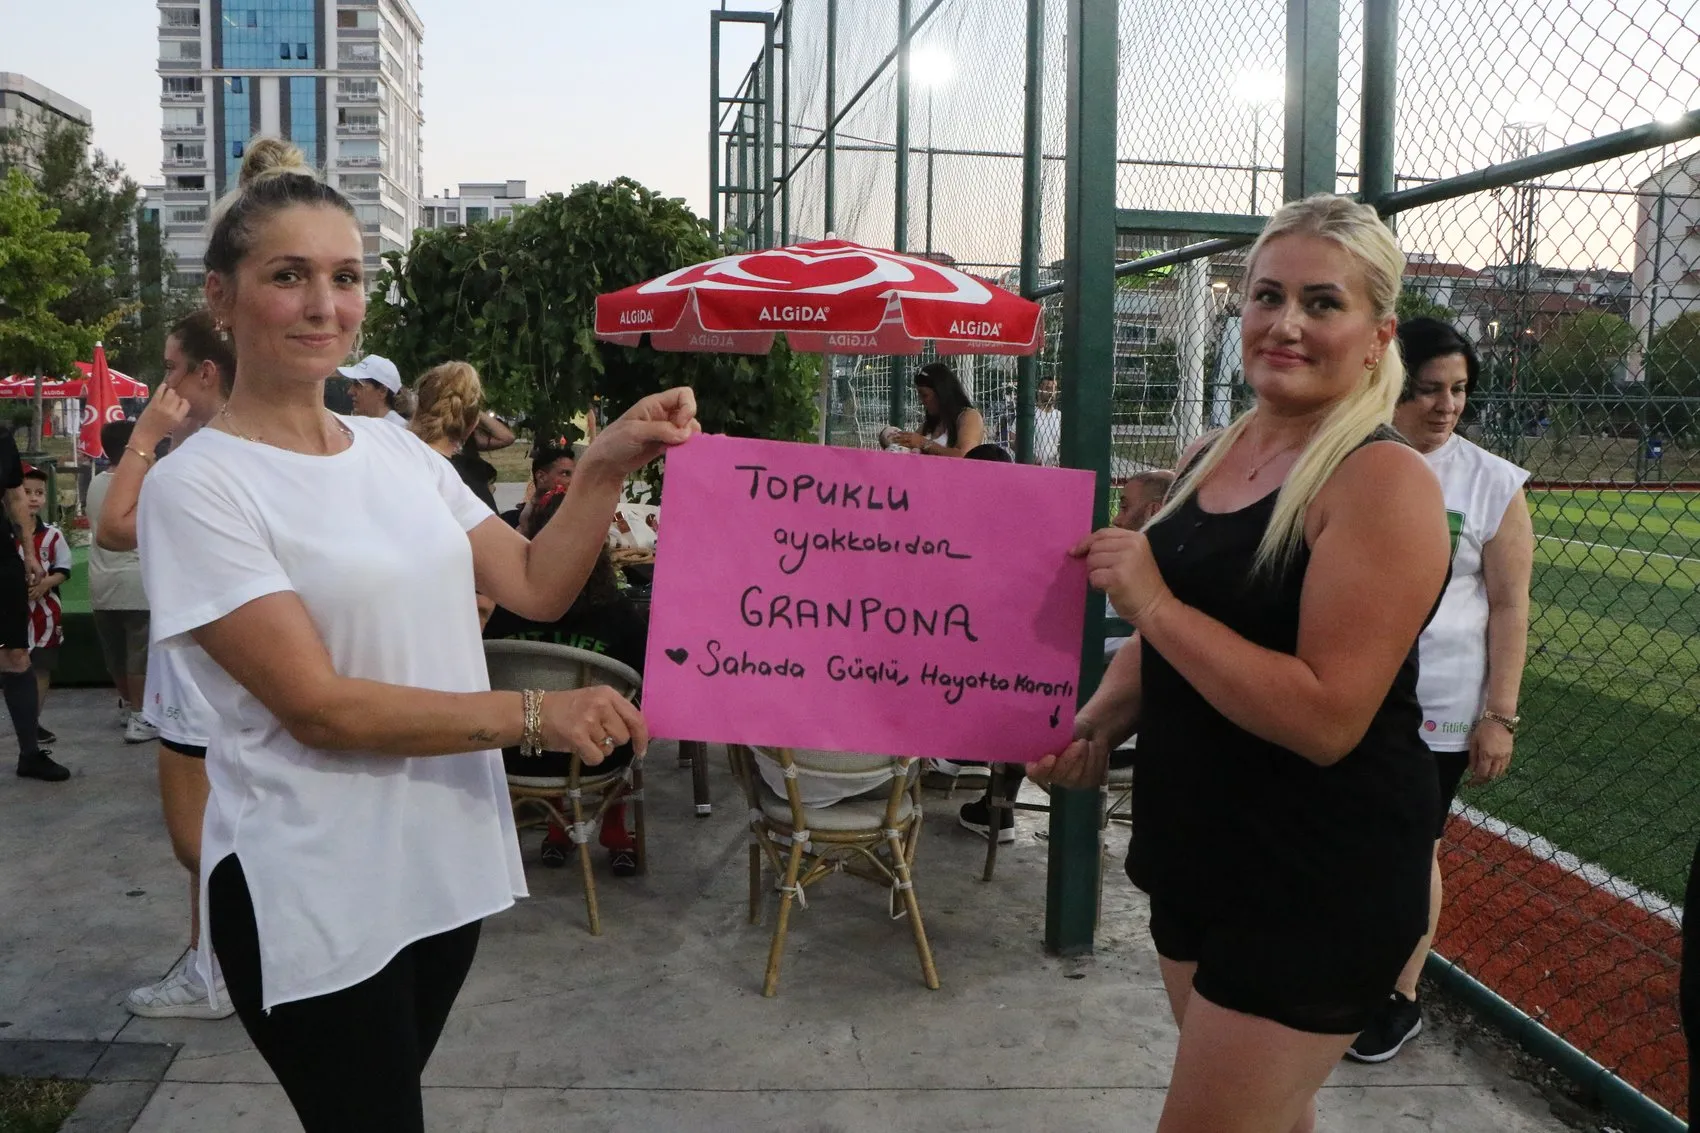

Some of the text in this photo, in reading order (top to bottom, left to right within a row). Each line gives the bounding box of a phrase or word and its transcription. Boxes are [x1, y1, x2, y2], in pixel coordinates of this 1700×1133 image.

[735, 465, 909, 512] TOPUKLU
[740, 586, 978, 643] GRANPONA
[697, 640, 805, 678] Sahada
[921, 663, 1009, 705] Hayatta
